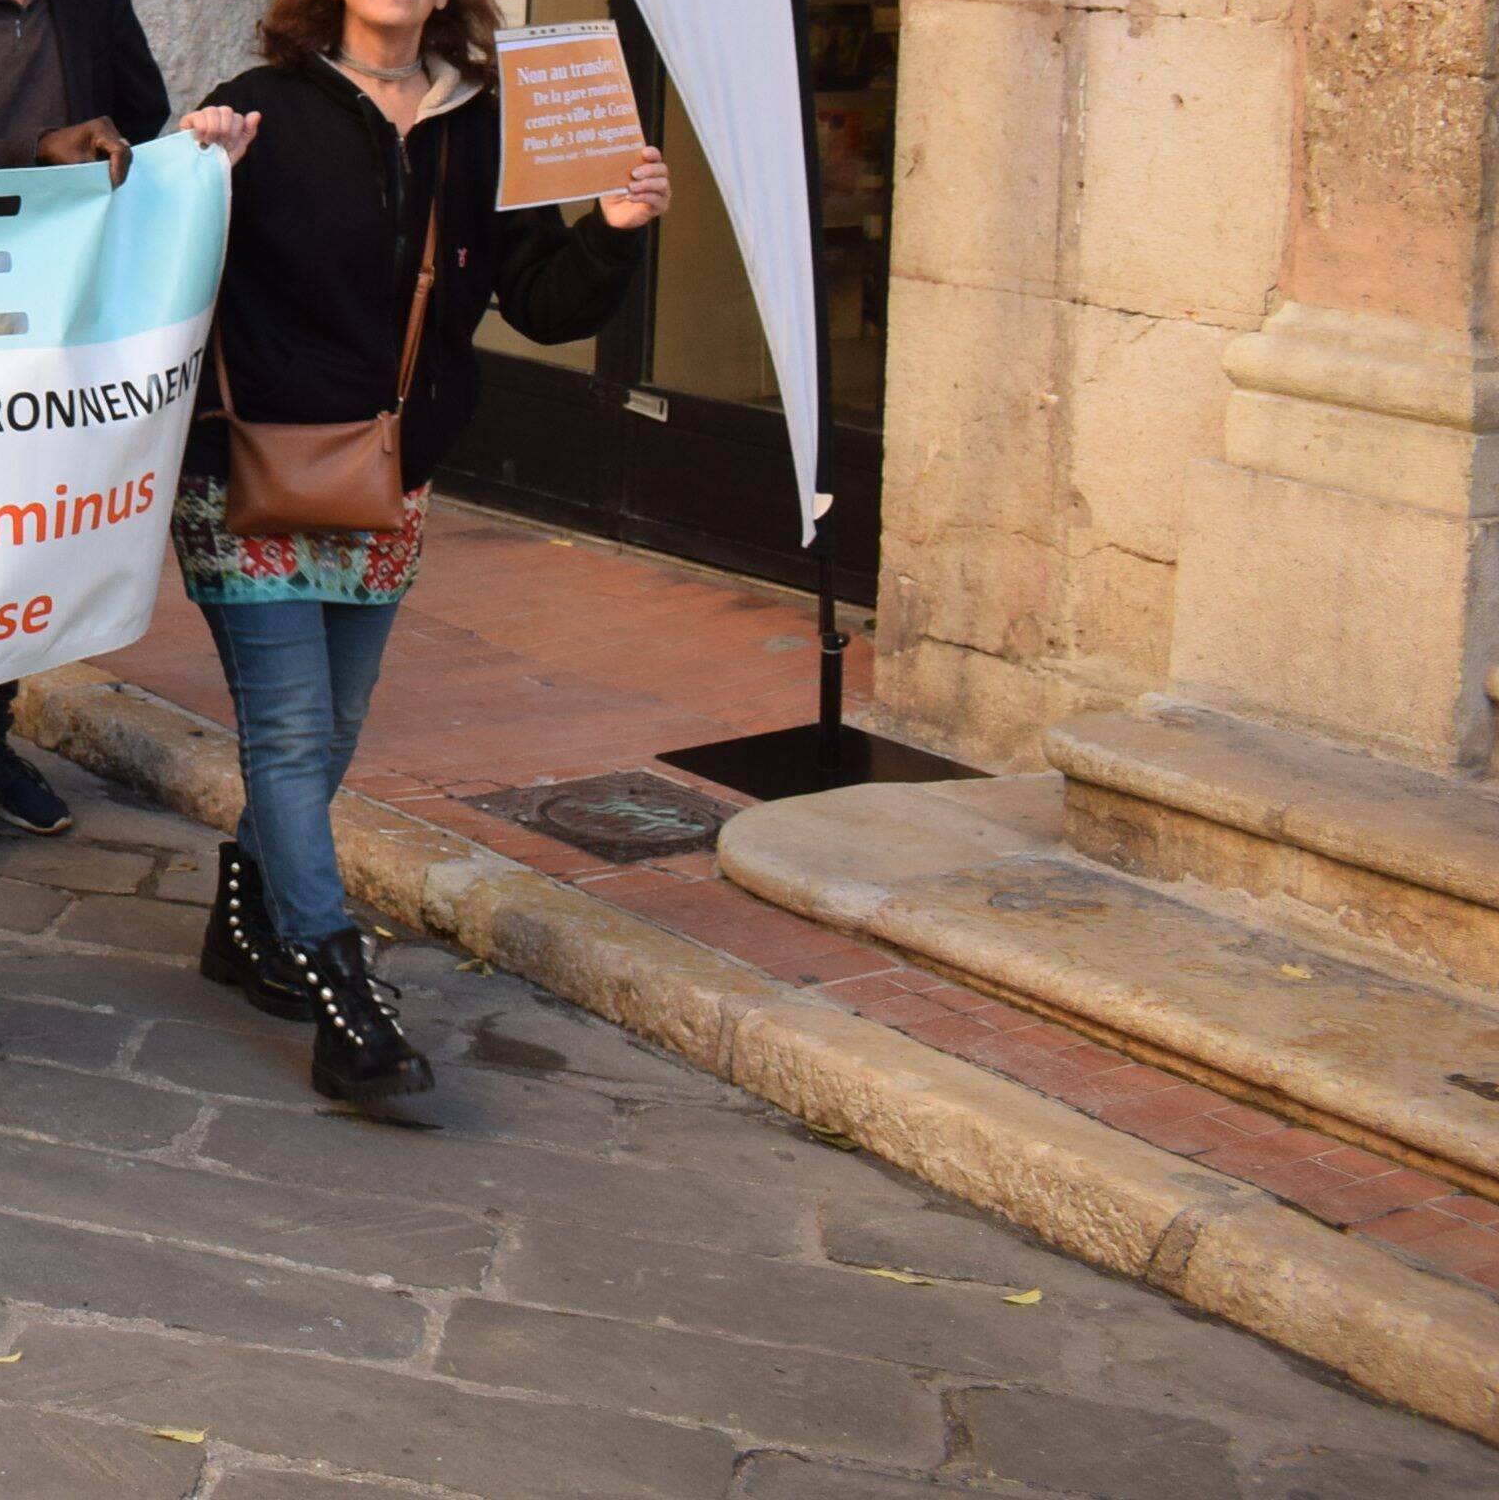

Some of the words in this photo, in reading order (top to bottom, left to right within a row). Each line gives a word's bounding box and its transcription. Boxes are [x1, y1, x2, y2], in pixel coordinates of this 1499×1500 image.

[516, 67, 548, 86] Non
[550, 66, 569, 81] au
[533, 92, 549, 107] De
[551, 89, 562, 104] la
[564, 88, 587, 105] gare
[593, 104, 607, 120] de
[522, 136, 549, 152] Plus
[550, 133, 565, 148] de
[566, 131, 574, 146] 3
